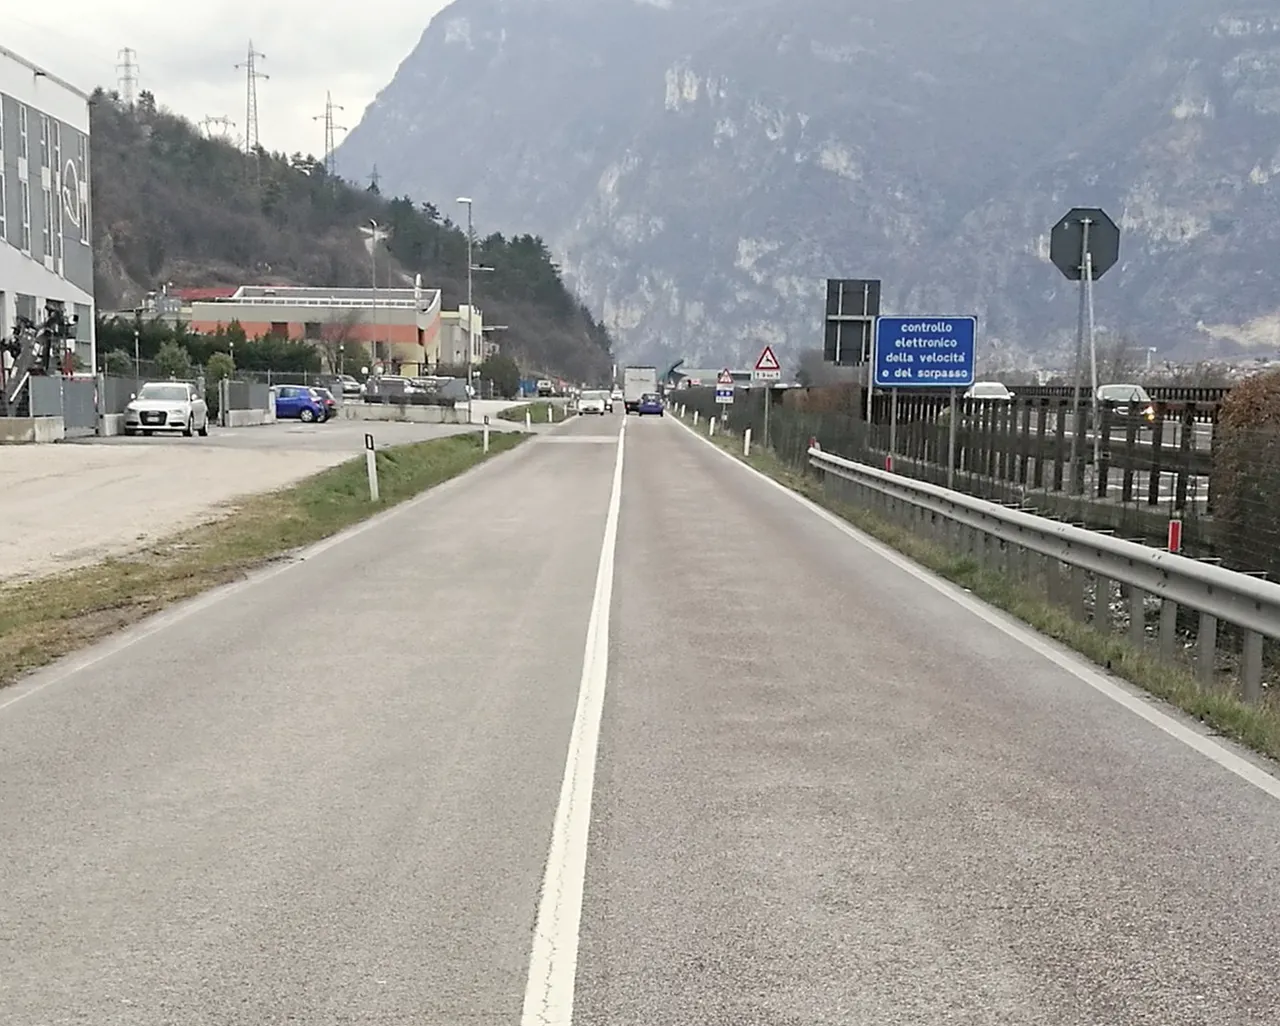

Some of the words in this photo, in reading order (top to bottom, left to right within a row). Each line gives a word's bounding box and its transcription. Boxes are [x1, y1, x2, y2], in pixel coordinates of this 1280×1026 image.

[901, 322, 952, 332] controllo
[895, 337, 958, 348] elettronico
[886, 352, 913, 363] della
[882, 369, 889, 377] e
[894, 368, 912, 377] del
[917, 369, 968, 379] sorpasso
